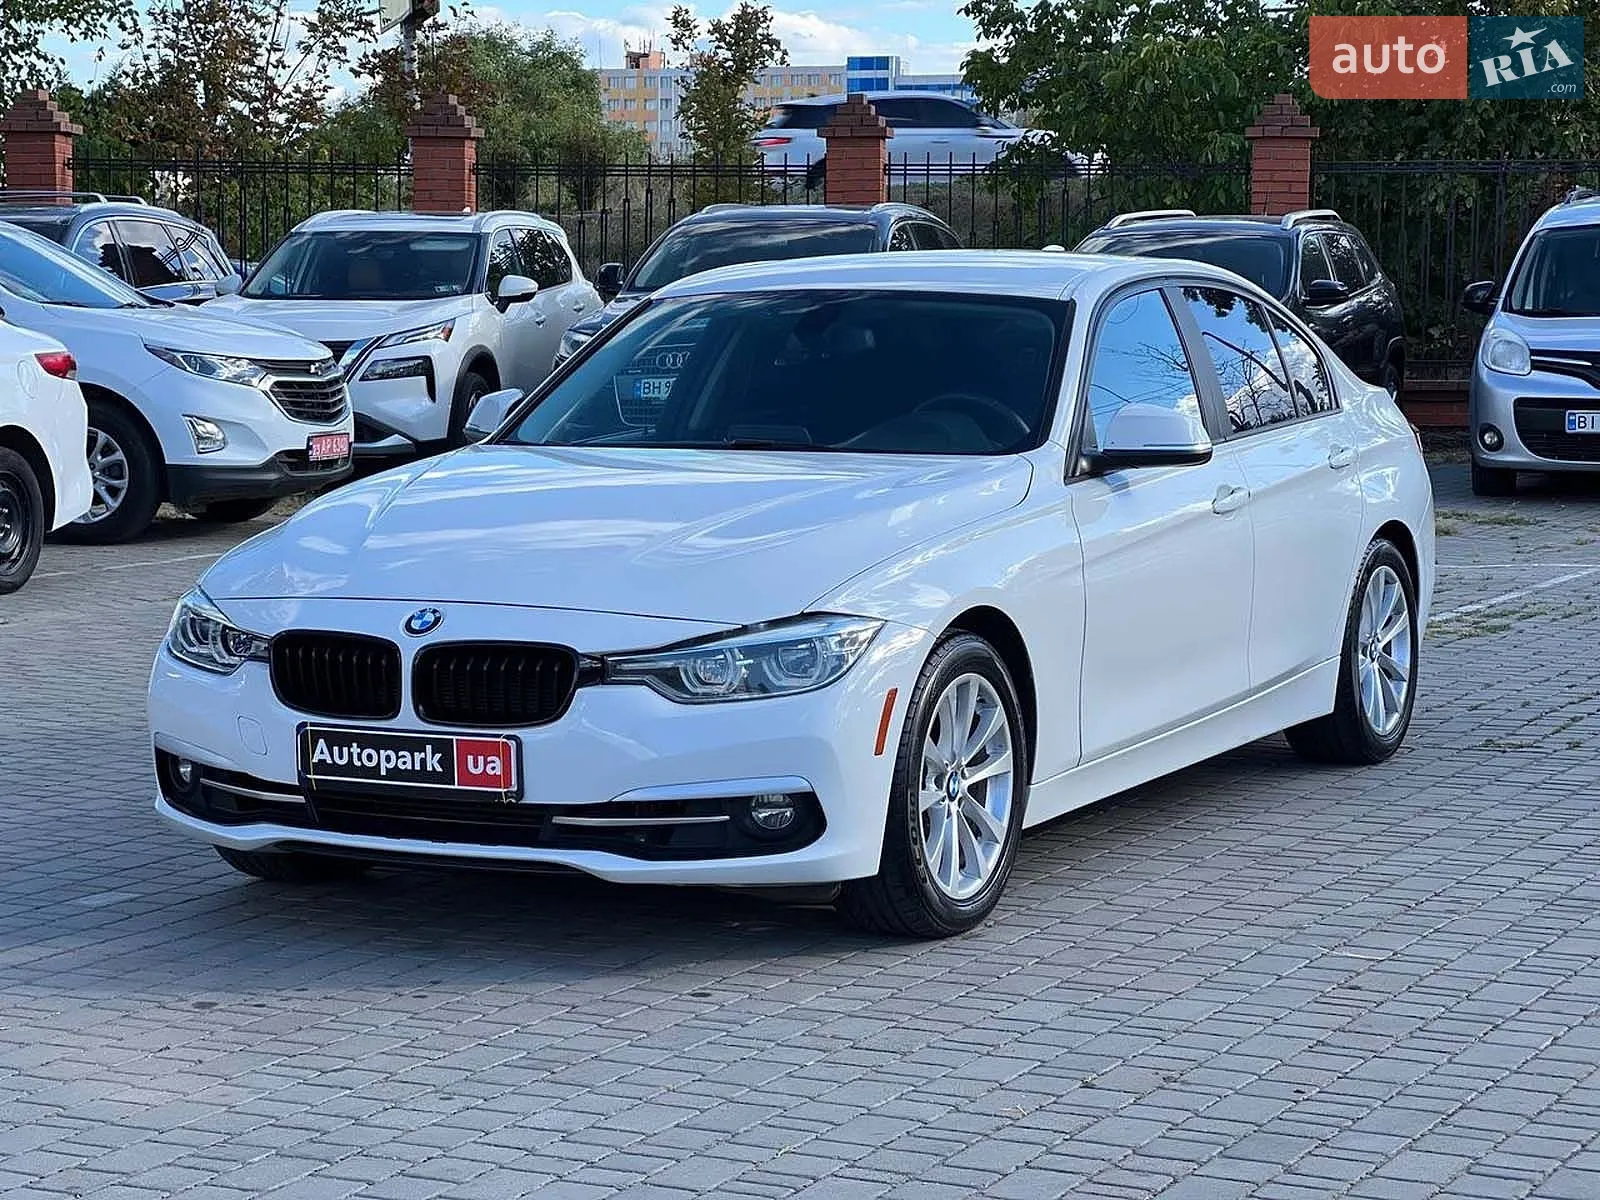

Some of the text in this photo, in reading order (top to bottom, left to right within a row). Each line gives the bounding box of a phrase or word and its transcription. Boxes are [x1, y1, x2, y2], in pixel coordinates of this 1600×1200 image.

[643, 381, 661, 395] BH
[1577, 415, 1595, 429] BI
[311, 738, 502, 776] Autopark ua
